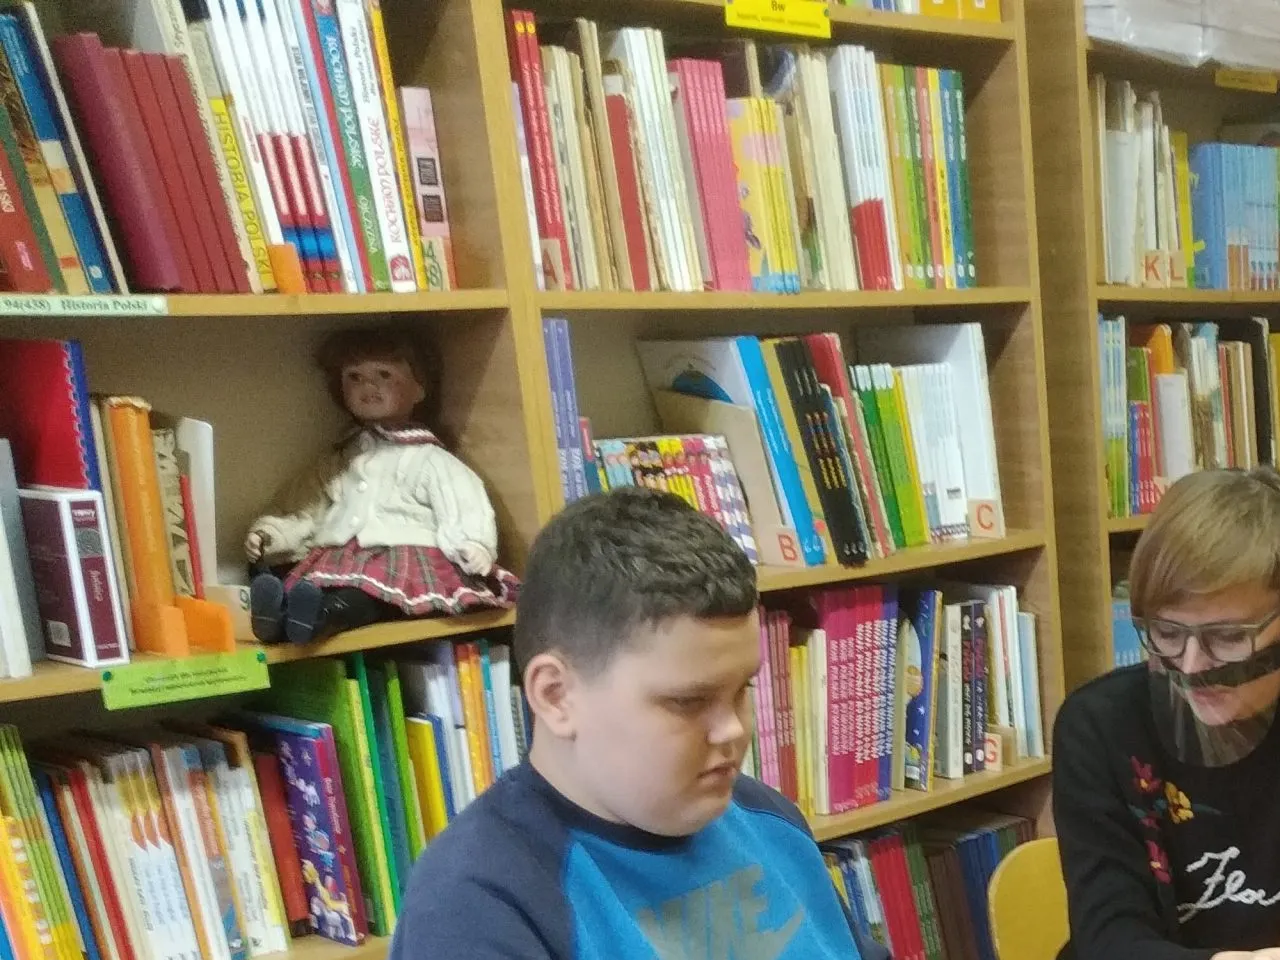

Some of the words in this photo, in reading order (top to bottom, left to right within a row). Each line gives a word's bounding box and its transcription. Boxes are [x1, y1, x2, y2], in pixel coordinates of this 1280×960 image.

[244, 210, 272, 276] POLSKI
[1142, 254, 1162, 282] K
[1168, 258, 1185, 282] L
[61, 299, 110, 311] Historia
[113, 299, 148, 311] Polski
[975, 503, 995, 532] C
[777, 533, 799, 562] B
